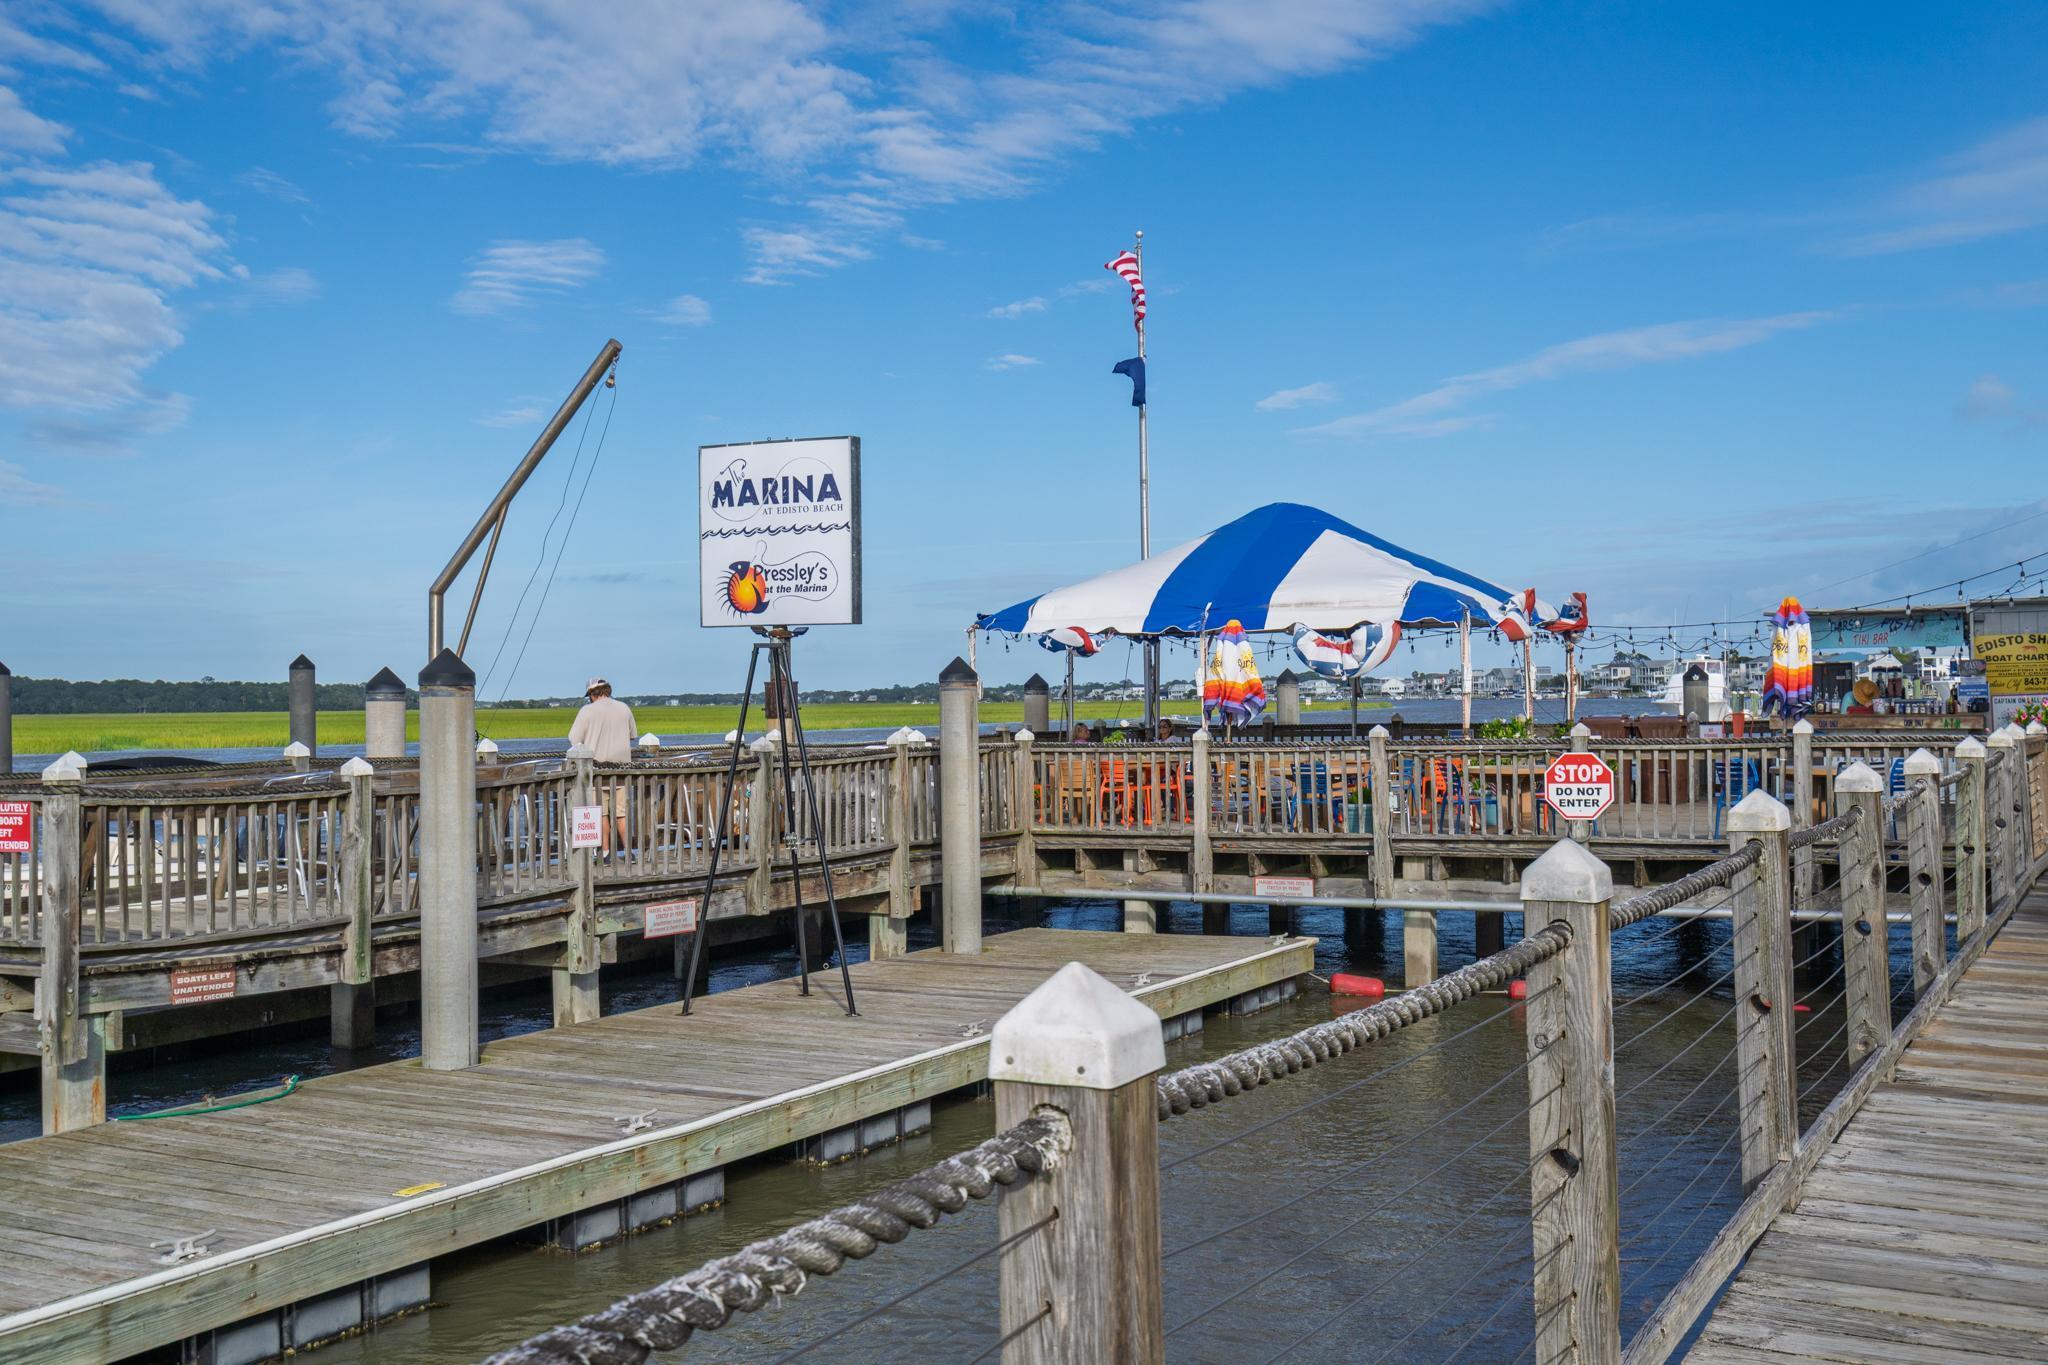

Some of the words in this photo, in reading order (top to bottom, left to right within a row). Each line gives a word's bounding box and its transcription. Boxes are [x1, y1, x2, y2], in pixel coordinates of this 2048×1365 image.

[720, 459, 746, 487] The
[712, 473, 842, 508] MARINA
[762, 507, 773, 516] AT
[776, 505, 809, 515] EDISTO
[813, 503, 843, 513] BEACH
[753, 562, 828, 585] Pressley's
[776, 585, 792, 594] the
[794, 584, 827, 593] Marina
[1853, 634, 1869, 646] TIKI
[1872, 632, 1889, 644] BAR
[1976, 635, 2024, 654] EDISTO
[2028, 634, 2048, 645] SH
[1985, 654, 2012, 662] BOAT
[2024, 677, 2048, 686] 843-7
[1554, 764, 1604, 783] STOP
[1556, 787, 1573, 796] DO
[1577, 787, 1602, 796] NOT
[1559, 798, 1600, 808] ENTER
[583, 812, 591, 820] NO
[577, 822, 596, 831] FISHING
[582, 832, 598, 841] MARINA
[176, 975, 208, 984] BOATS
[209, 972, 231, 980] LEFT
[174, 982, 234, 995] UNATTENDED
[175, 996, 202, 1005] WITHOUT
[203, 992, 234, 1001] CHECKING
